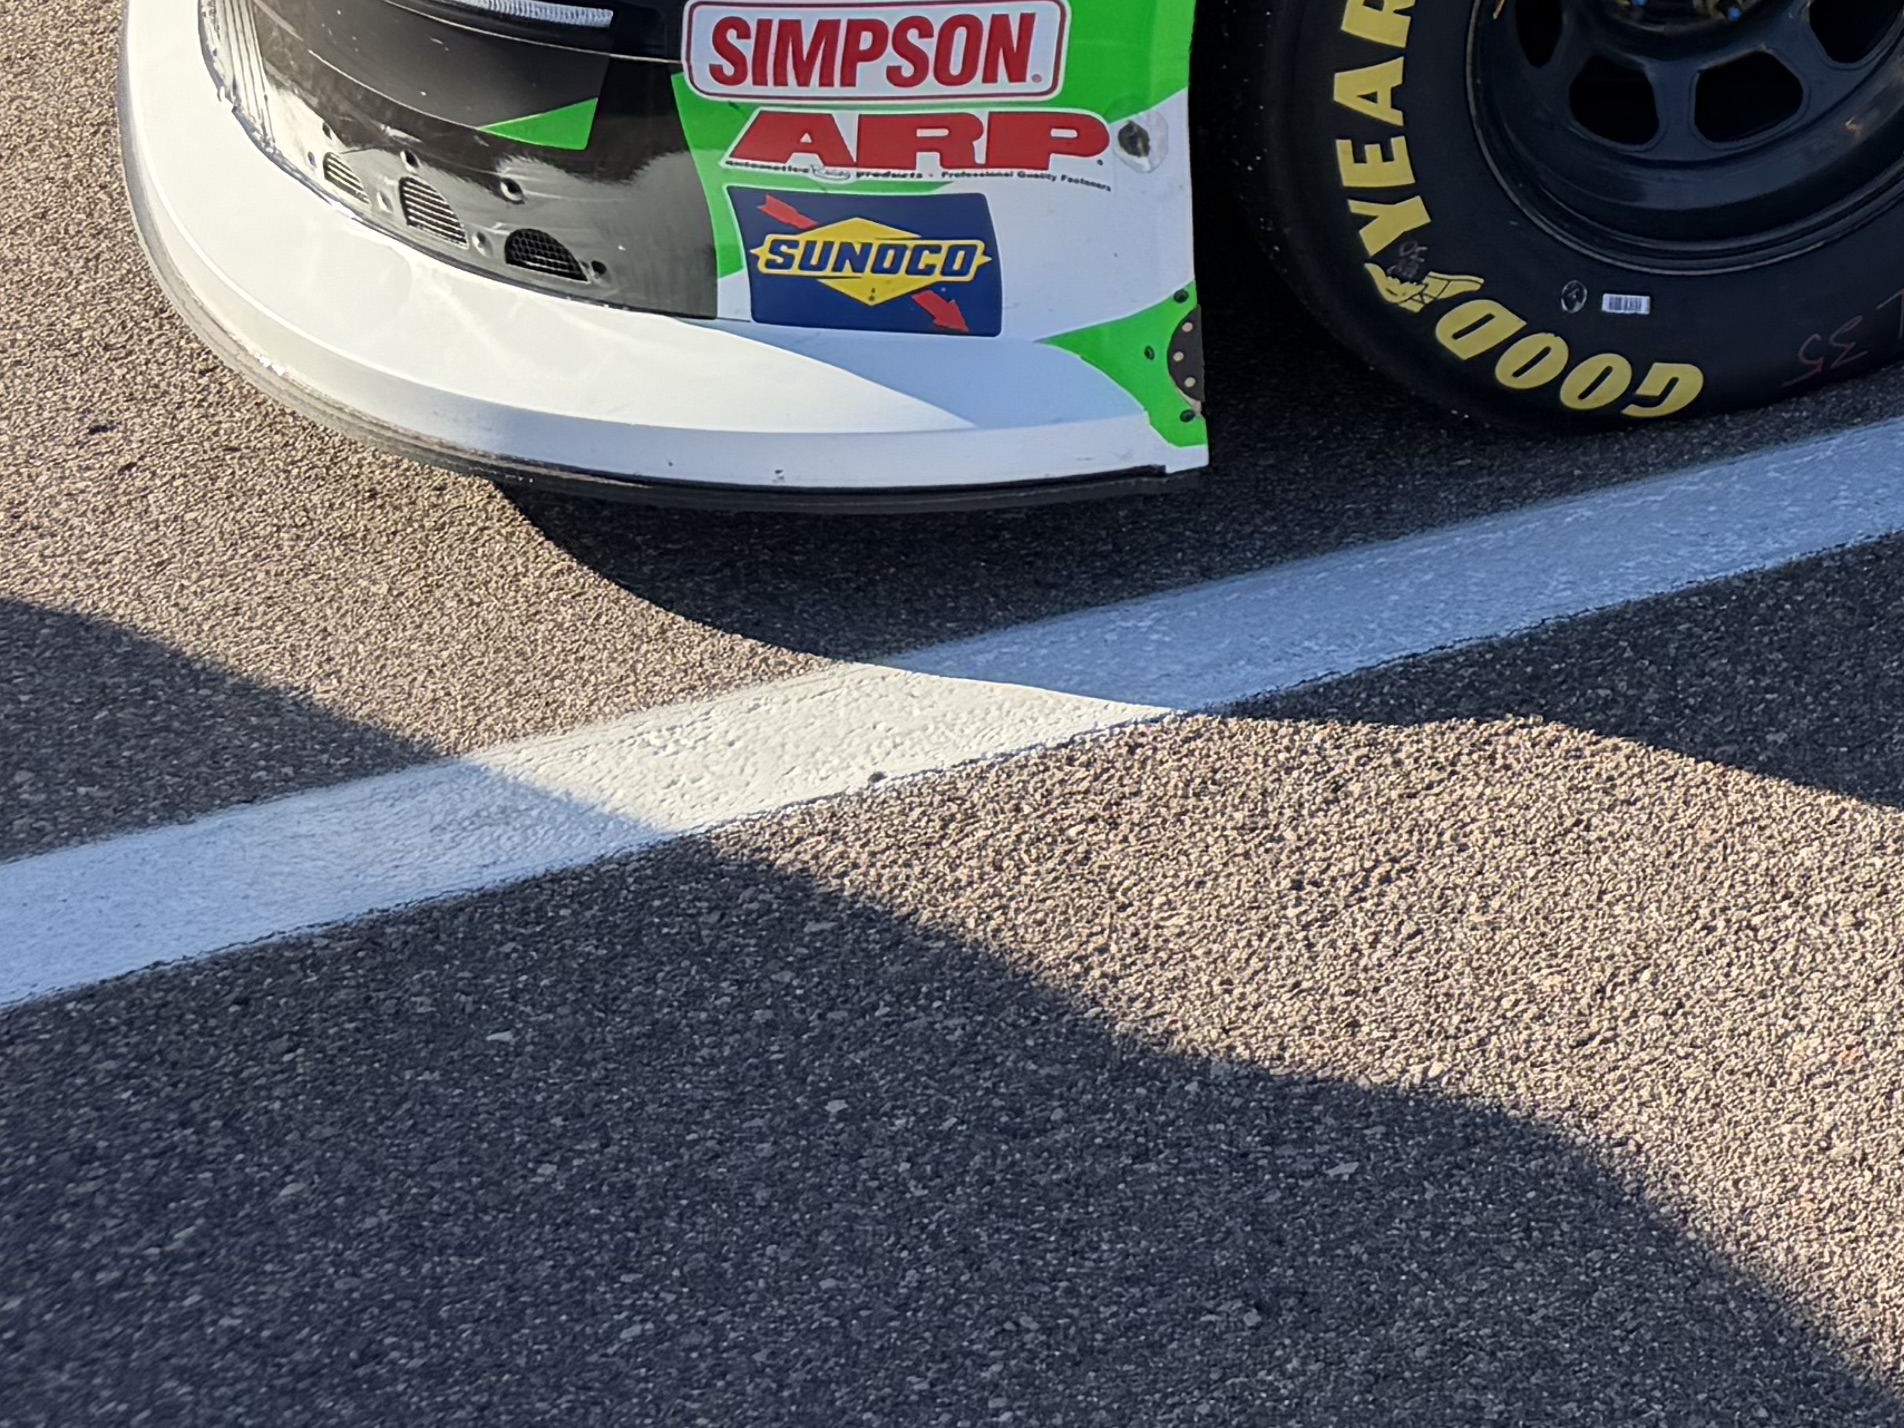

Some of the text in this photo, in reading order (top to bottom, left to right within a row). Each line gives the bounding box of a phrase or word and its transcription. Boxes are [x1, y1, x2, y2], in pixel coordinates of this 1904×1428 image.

[709, 12, 1037, 87] SIMPSON
[729, 110, 1111, 172] ARP
[762, 240, 976, 276] SUNOCO
